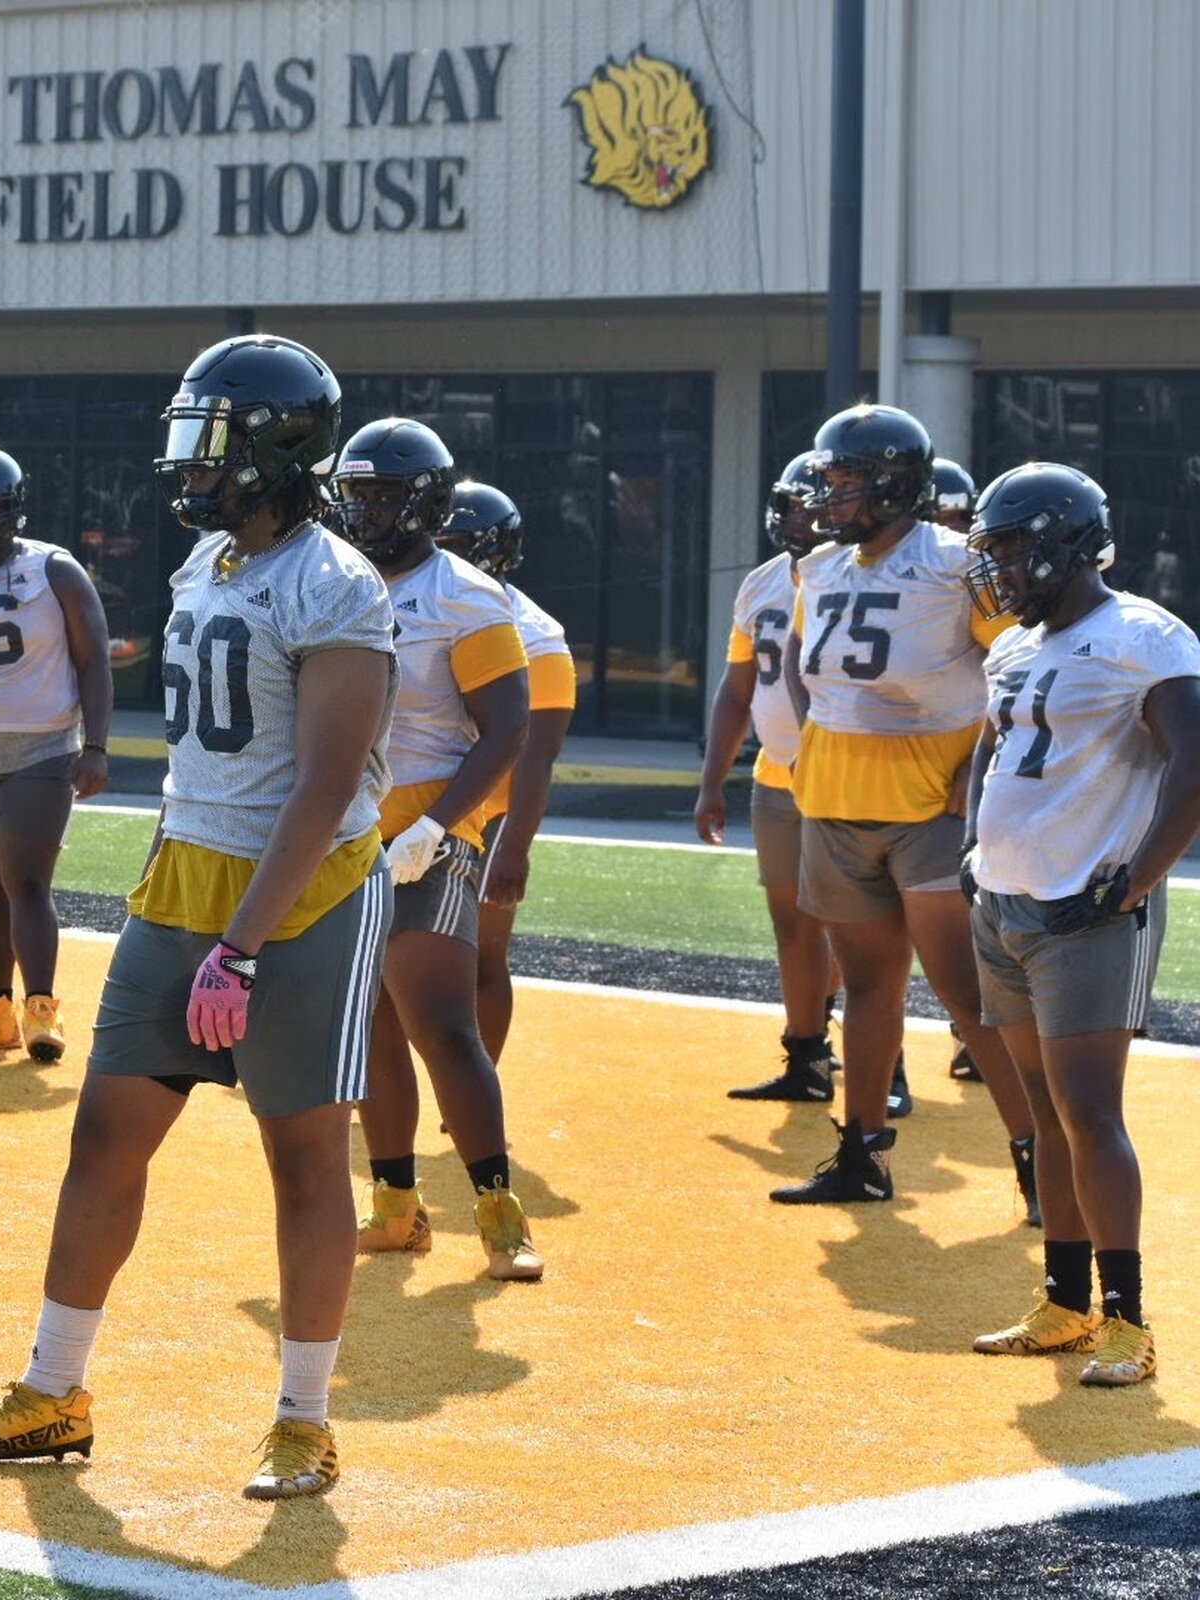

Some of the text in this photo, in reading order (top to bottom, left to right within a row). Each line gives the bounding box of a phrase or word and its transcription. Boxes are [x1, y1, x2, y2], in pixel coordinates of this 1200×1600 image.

[7, 56, 317, 148] THOMAS
[343, 42, 514, 130] MAY
[213, 155, 468, 240] HOUSE
[754, 608, 788, 687] 6
[804, 591, 901, 681] 75
